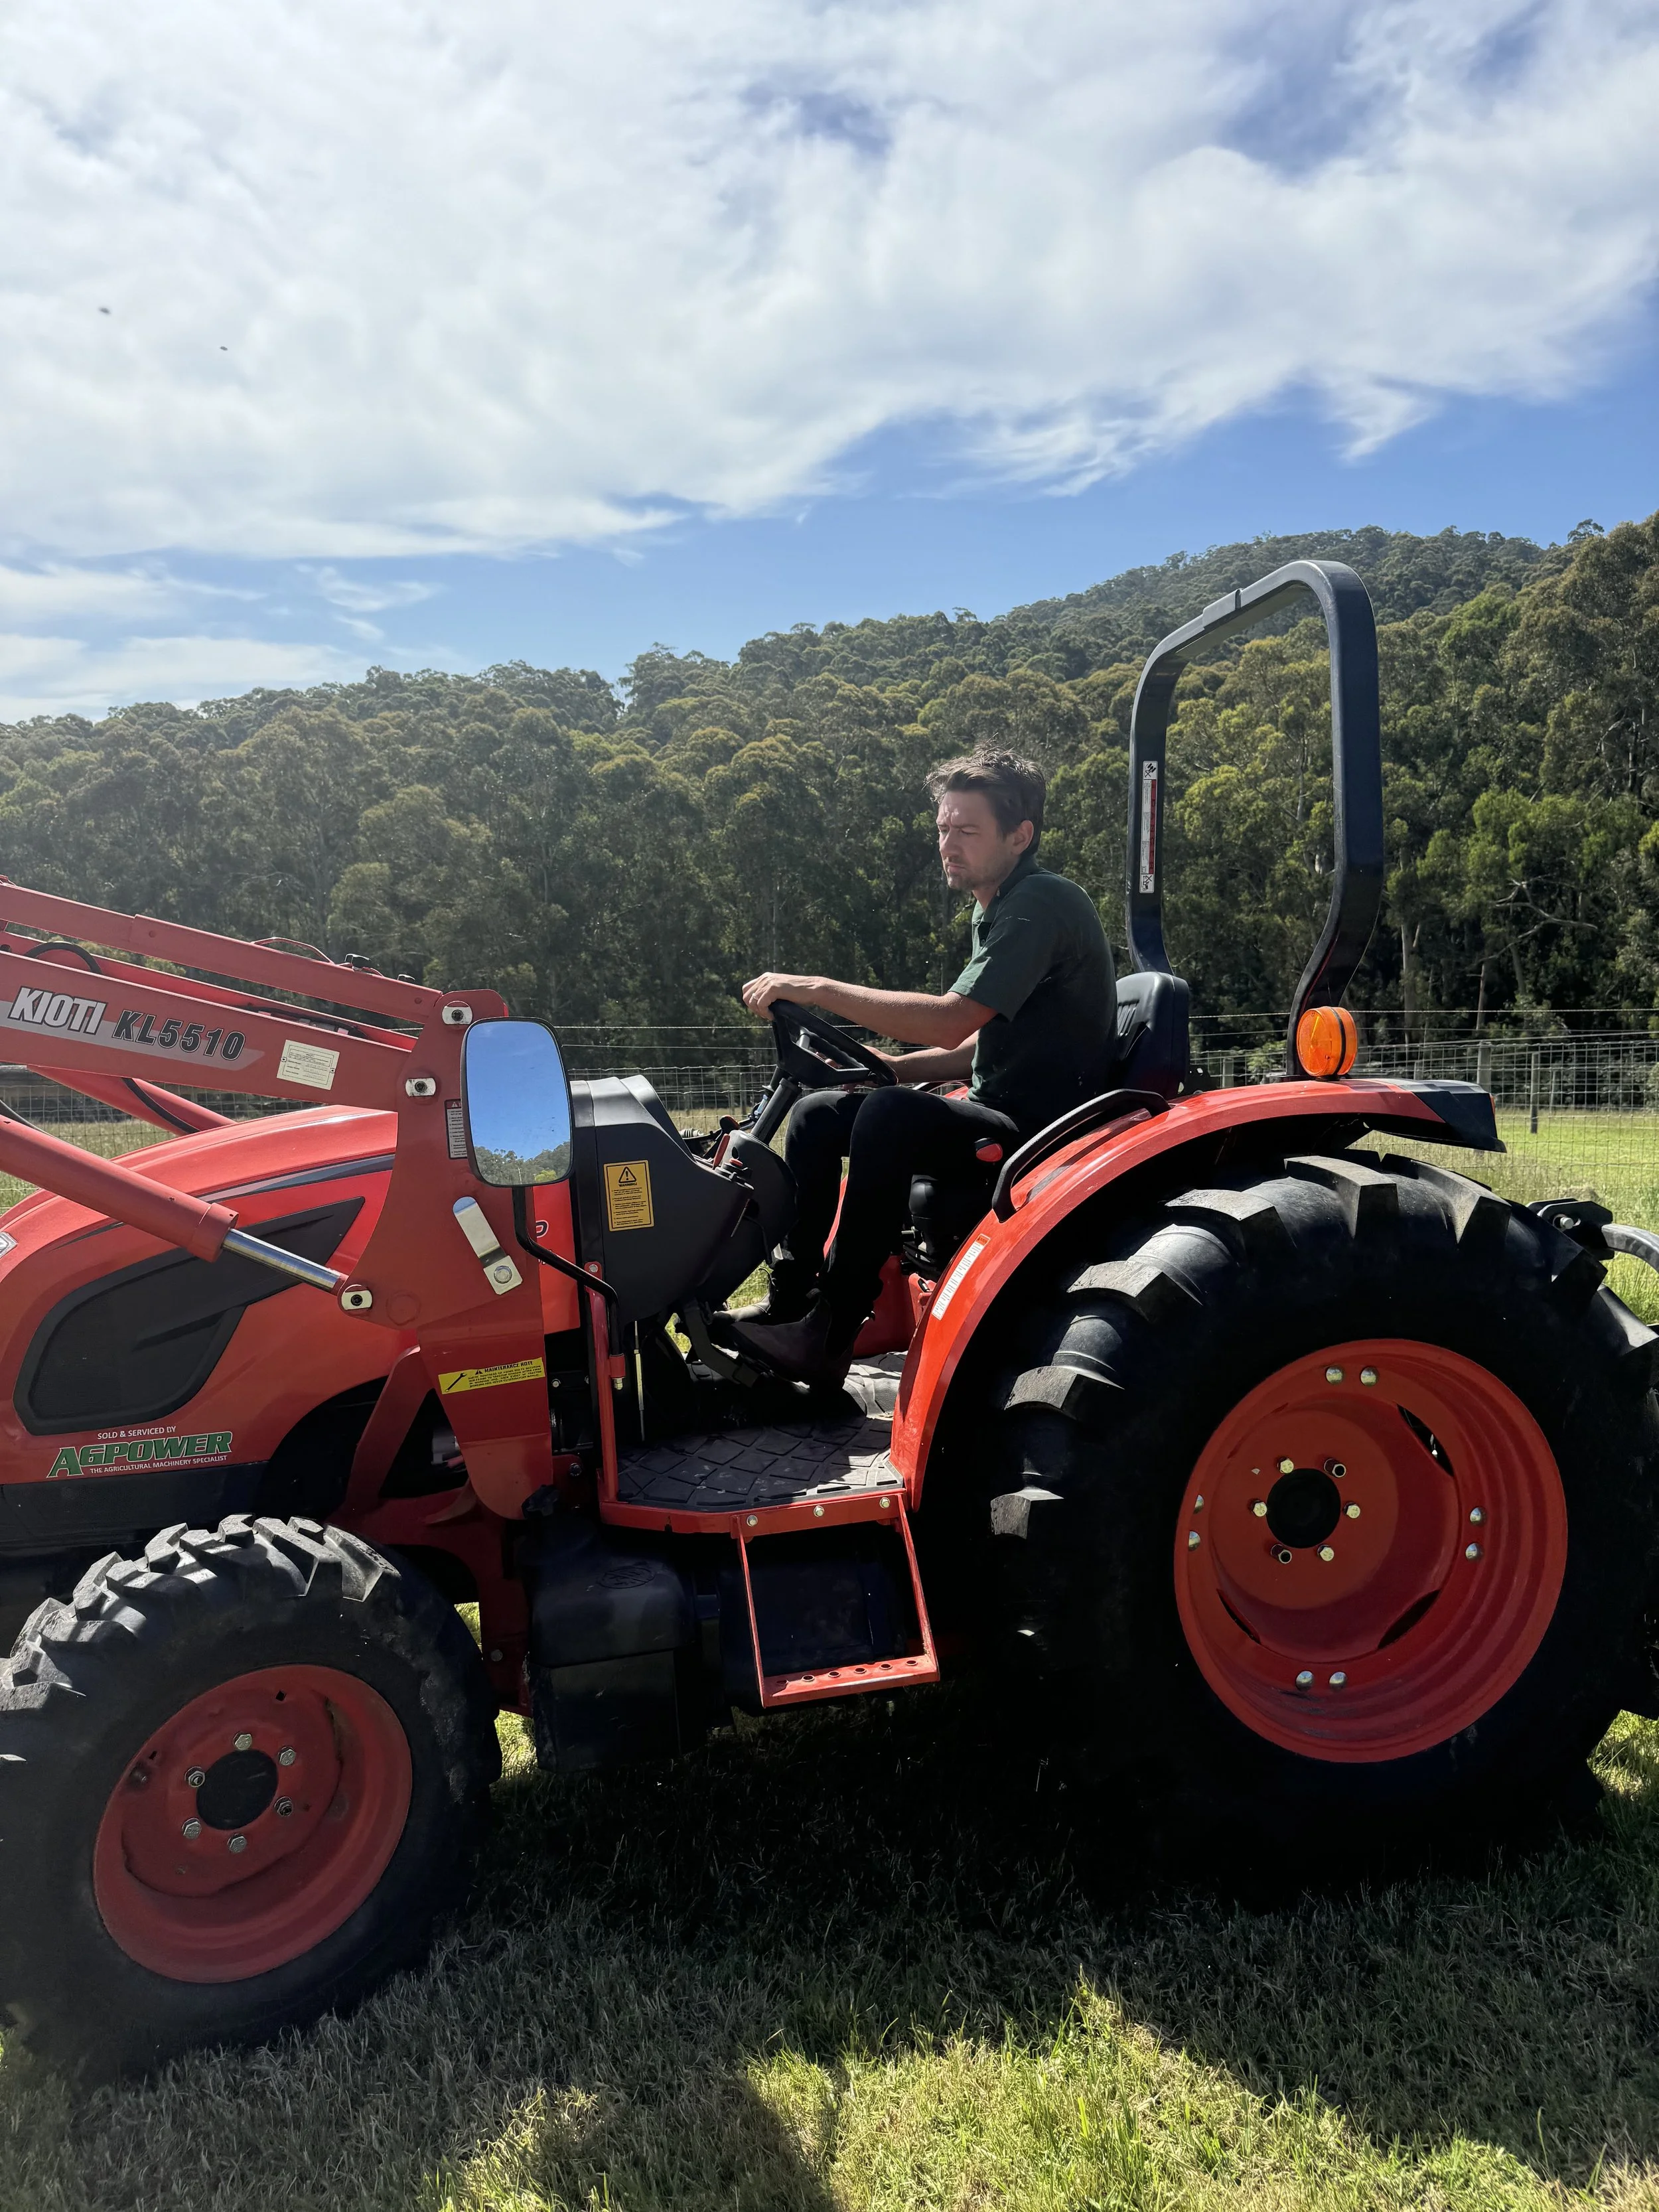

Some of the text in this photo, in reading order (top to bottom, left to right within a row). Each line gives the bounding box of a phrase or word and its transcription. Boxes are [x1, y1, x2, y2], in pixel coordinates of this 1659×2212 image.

[8, 986, 246, 1061] KIOTI KL5510
[98, 1432, 118, 1440] SOLD
[128, 1427, 165, 1437] SERVICED
[46, 1432, 232, 1478] AGPOWER
[104, 1462, 152, 1473] AGRICULTURAL
[153, 1459, 192, 1468] MACHINERY
[192, 1455, 228, 1465] SPECIALIST
